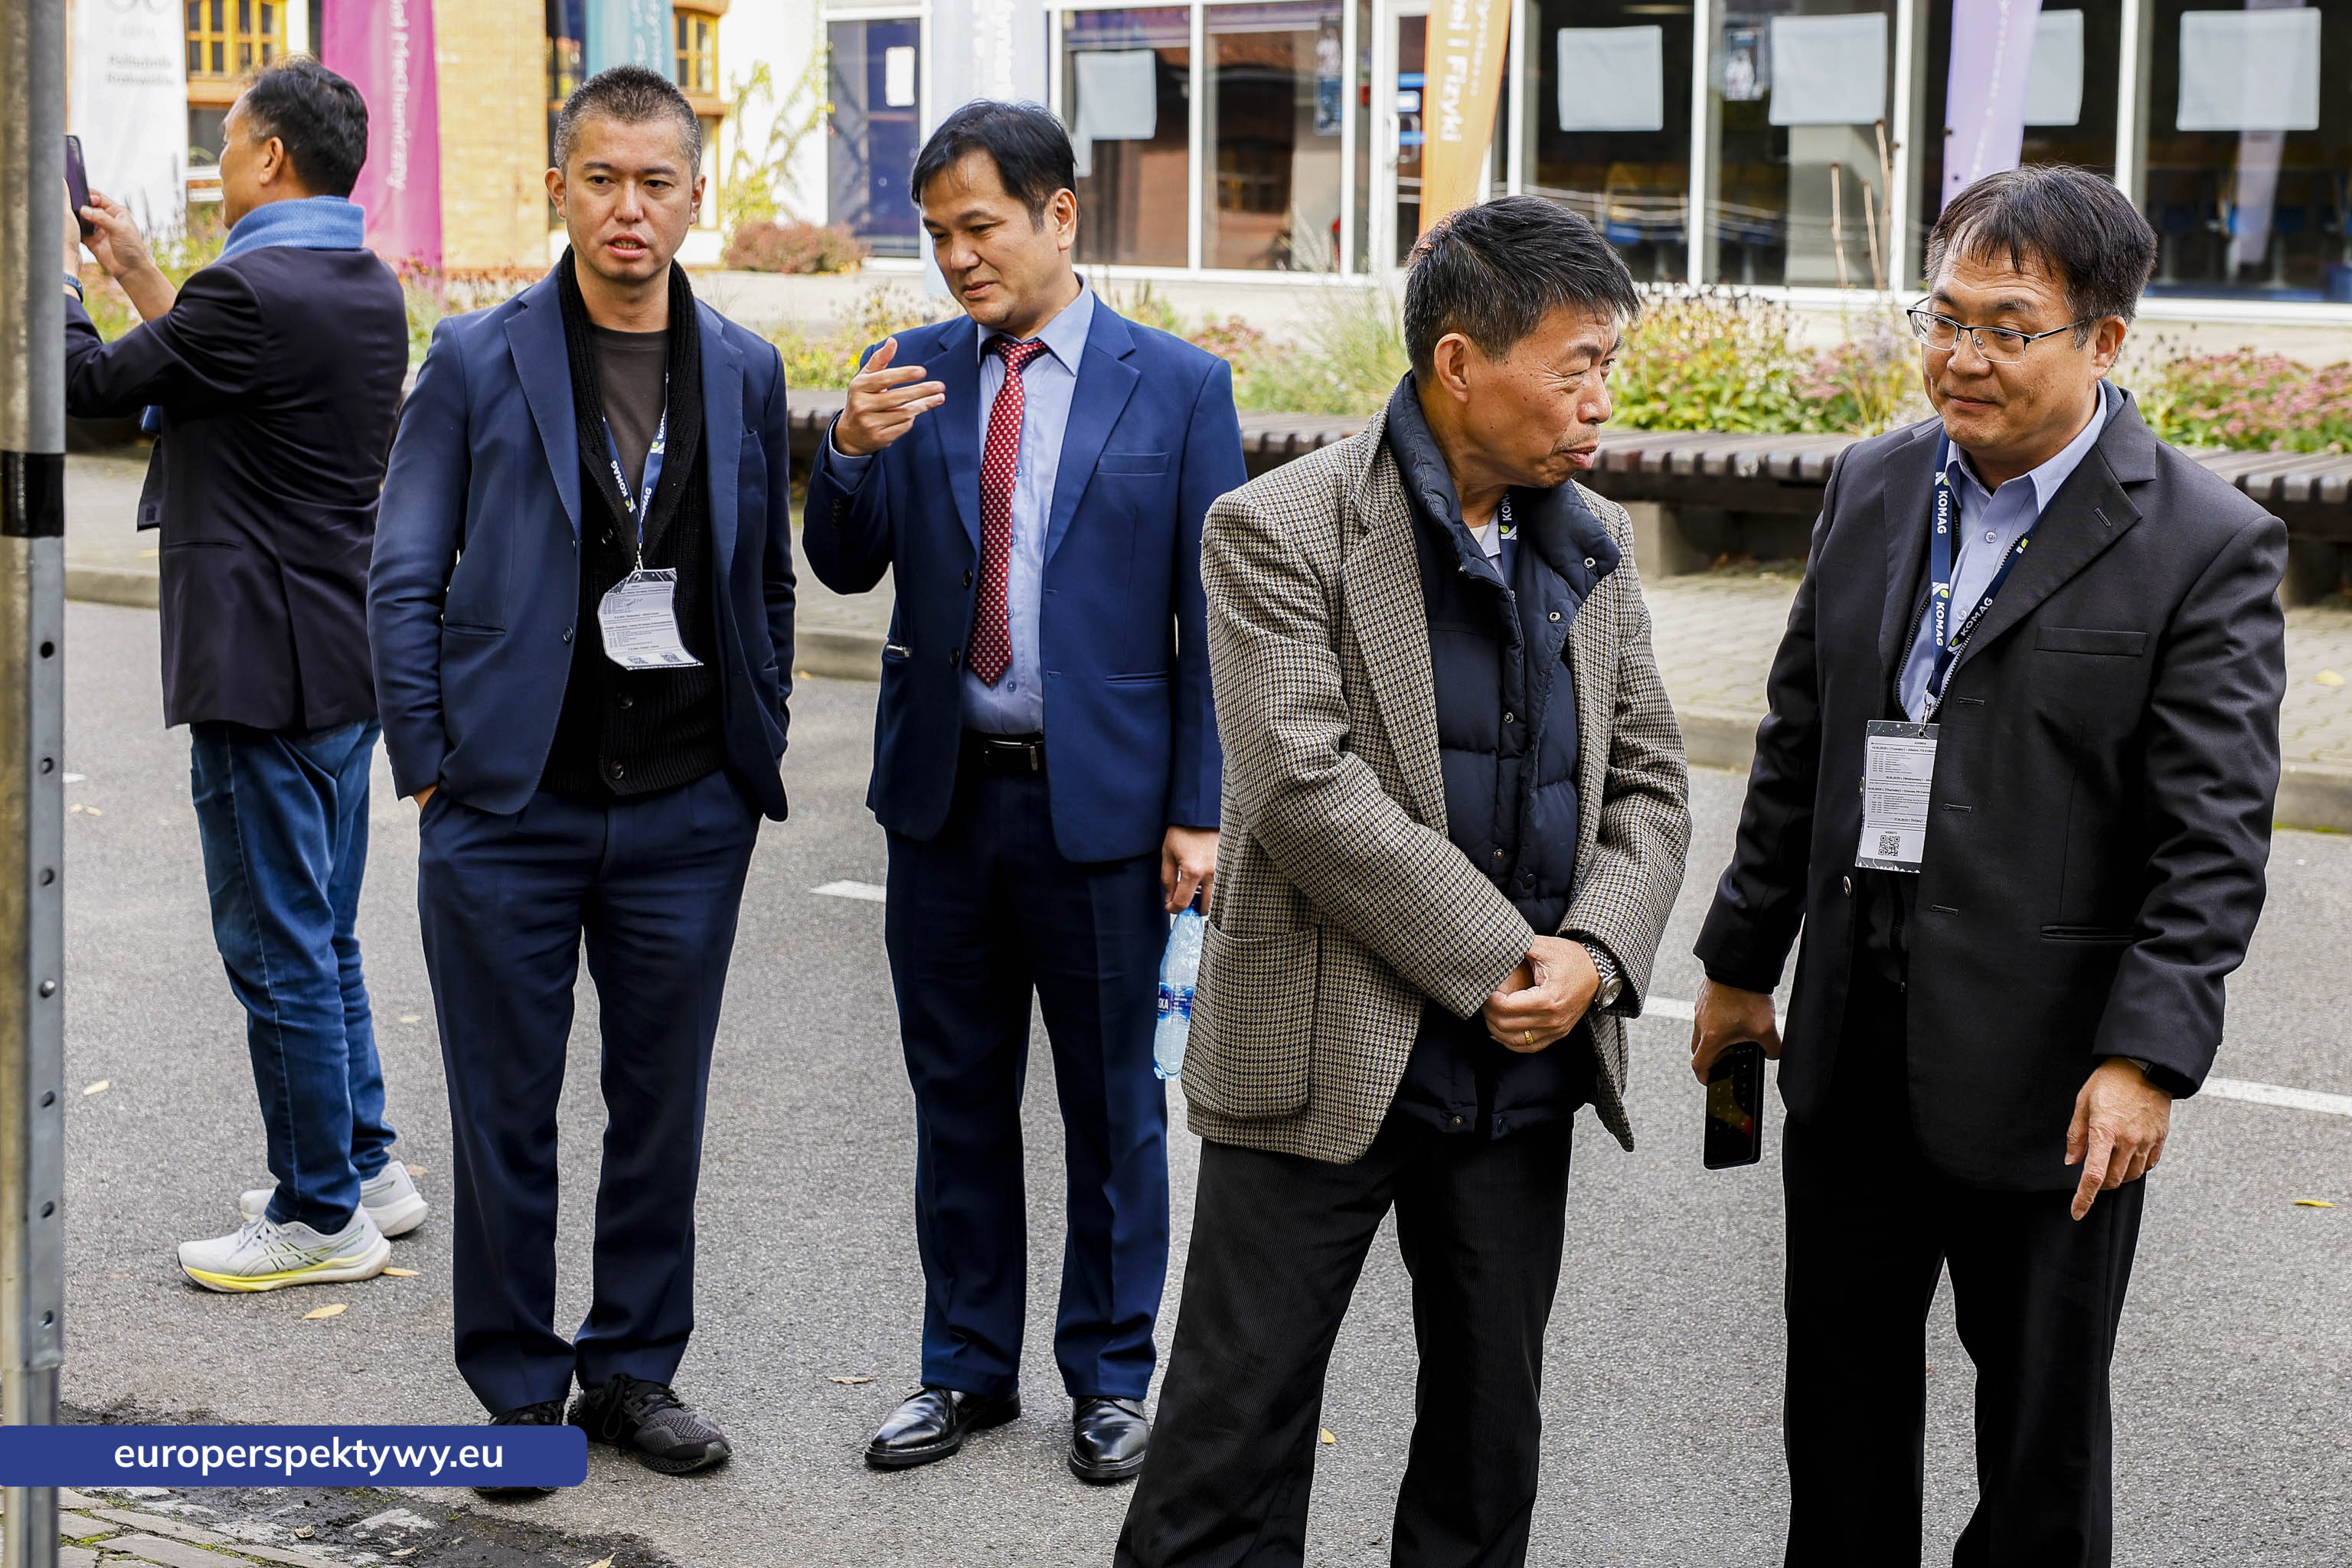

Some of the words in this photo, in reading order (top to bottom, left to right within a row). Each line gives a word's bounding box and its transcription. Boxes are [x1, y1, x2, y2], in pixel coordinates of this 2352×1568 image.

[610, 460, 629, 498] KOMAG
[1936, 490, 1949, 534] KOMAG
[1936, 601, 1945, 647] KOMAG
[1960, 596, 1993, 638] KOMAG
